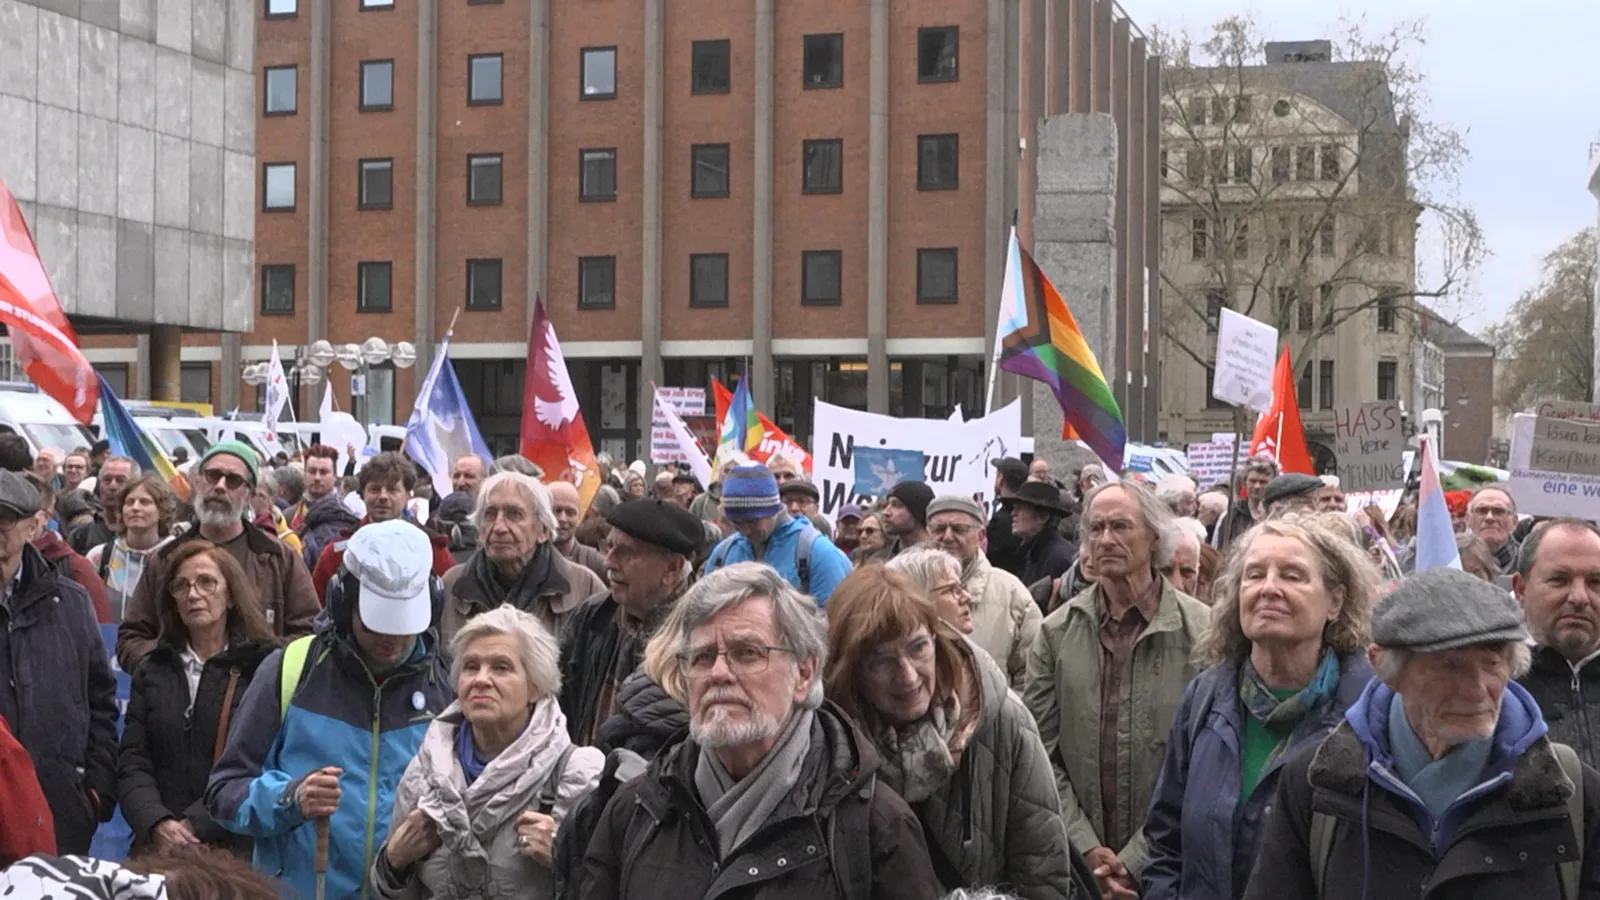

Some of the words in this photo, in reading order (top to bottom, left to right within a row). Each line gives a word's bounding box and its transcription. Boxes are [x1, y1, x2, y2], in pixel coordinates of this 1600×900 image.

[1334, 405, 1396, 438] HASS
[1547, 424, 1579, 441] lösen
[1536, 445, 1597, 470] Konflikt
[1543, 480, 1578, 496] eine
